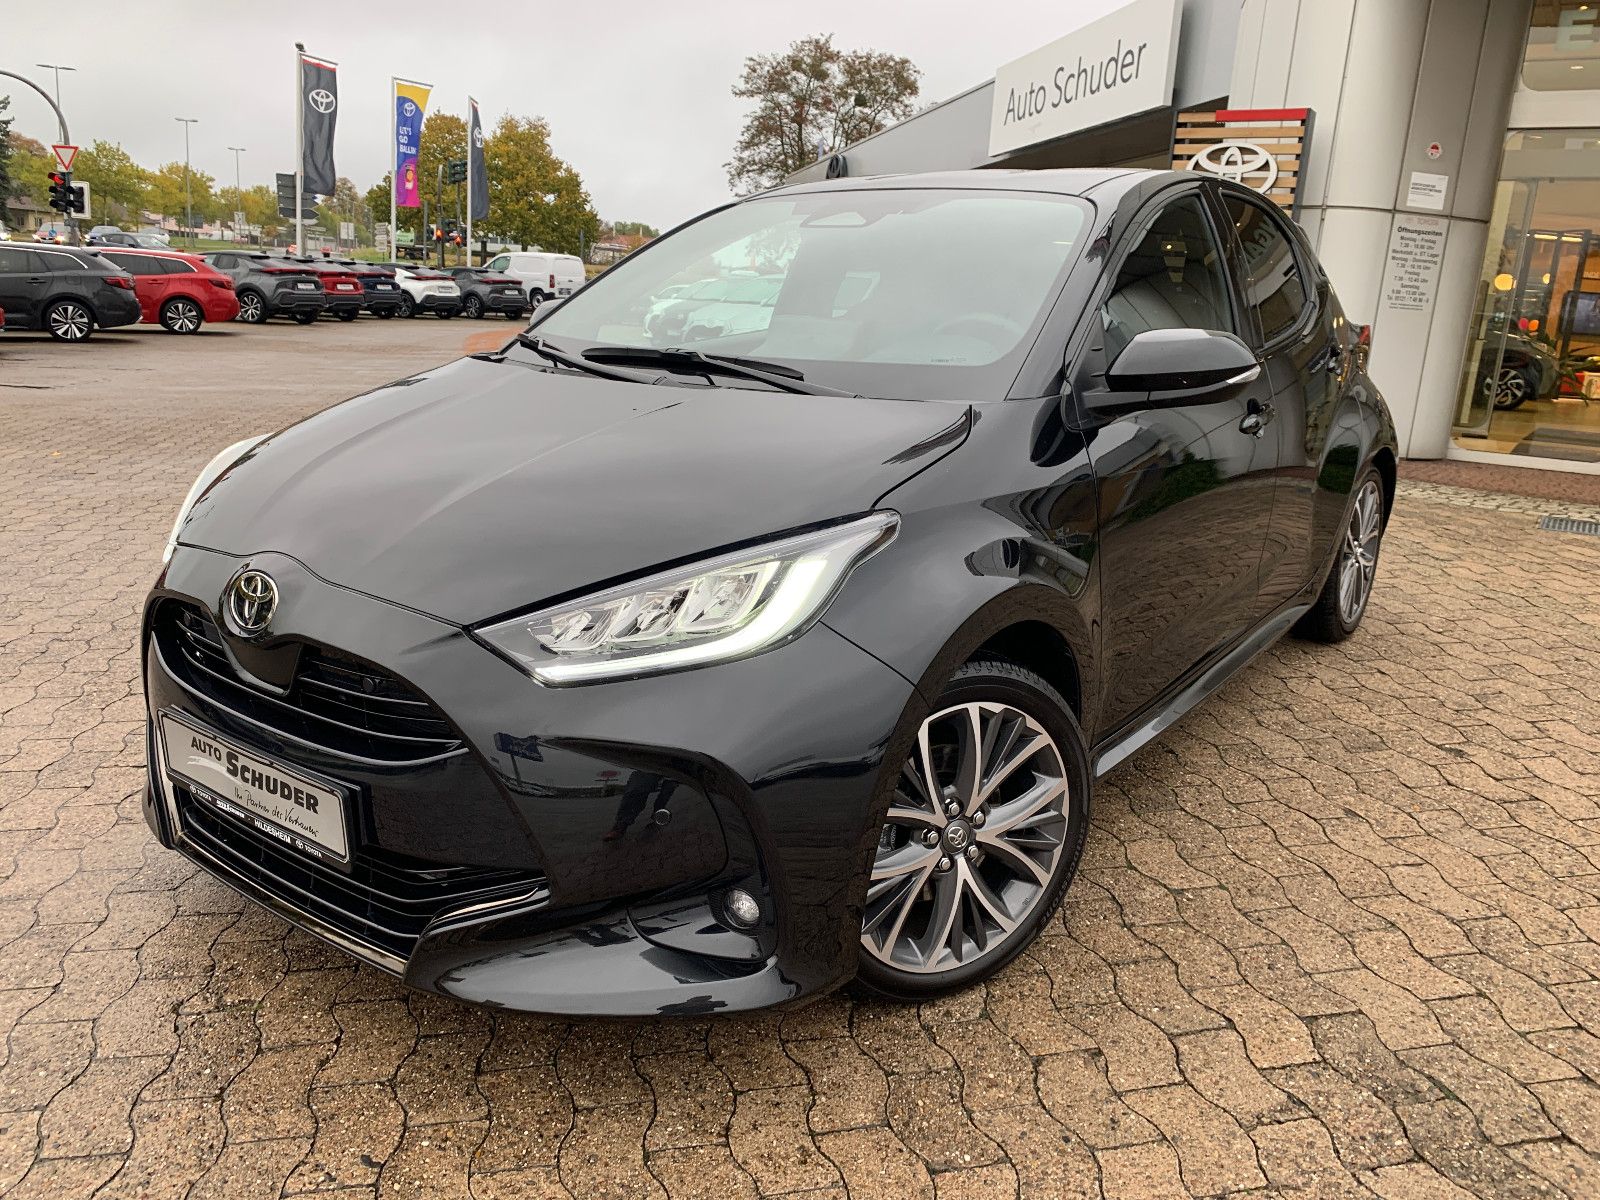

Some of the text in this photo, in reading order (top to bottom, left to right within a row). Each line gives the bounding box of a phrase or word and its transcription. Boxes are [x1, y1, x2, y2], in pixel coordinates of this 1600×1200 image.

[1004, 39, 1147, 126] Auto Schuder
[399, 135, 408, 143] GO
[191, 736, 222, 761] AUTO
[254, 819, 292, 844] HILDESHEIM
